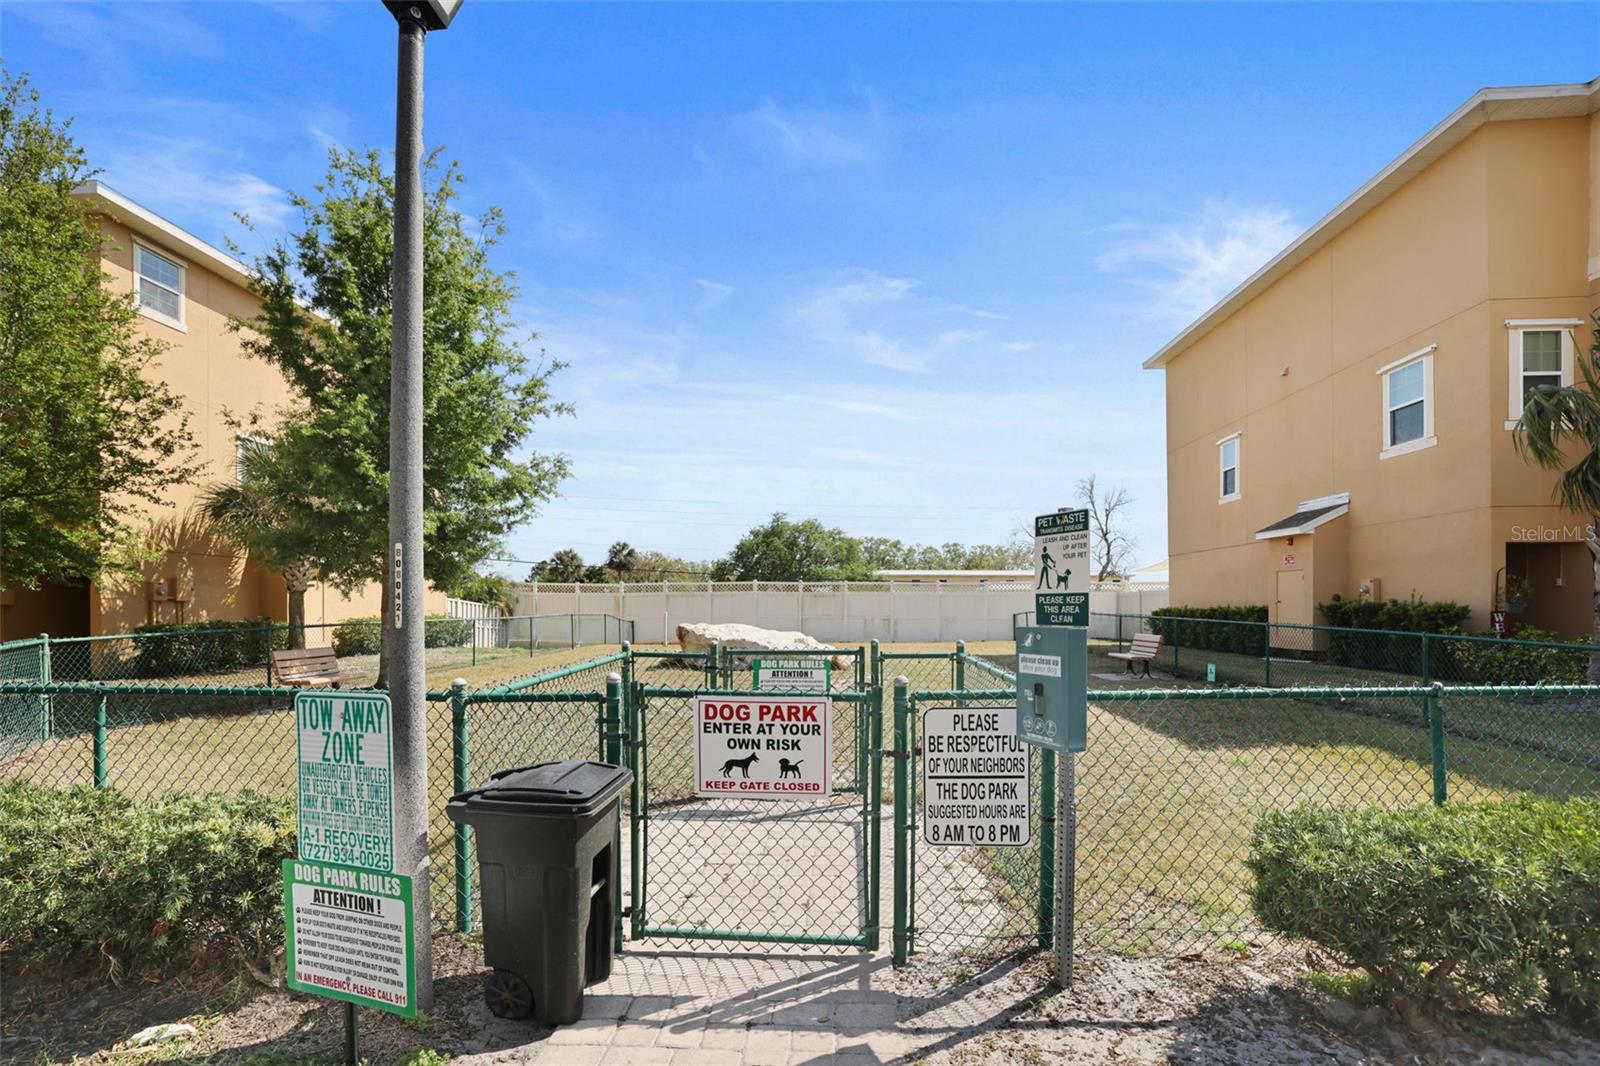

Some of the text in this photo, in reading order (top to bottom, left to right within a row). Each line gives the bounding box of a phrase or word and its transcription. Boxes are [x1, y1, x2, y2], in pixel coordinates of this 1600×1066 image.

[1038, 512, 1085, 528] PET WASTE
[1064, 523, 1084, 532] DISEASE
[1042, 536, 1058, 544] LEASH
[1070, 532, 1088, 541] CLEAN
[1071, 542, 1088, 550] AFTER
[1062, 551, 1087, 560] YOUR PET
[1038, 595, 1085, 605] PLEASE KEEP
[1044, 605, 1080, 614] THIS AREA
[761, 660, 825, 668] DOG PARK RULES
[300, 699, 385, 734] TOW AWAY
[704, 703, 818, 722] DOG PARK
[703, 722, 821, 736] ENTER AT YOUR
[953, 714, 999, 731] PLEASE
[322, 731, 365, 765] ZONE
[727, 738, 801, 751] OWN RISK
[928, 735, 944, 753] BE
[947, 735, 1024, 753] RESPECTFUL
[302, 761, 388, 785] UNAUTHORIZED VEHICLES
[929, 757, 1025, 773] OF YOUR NEIGHBORS
[312, 779, 338, 797] VESSELS
[340, 781, 354, 799] WILL
[356, 783, 364, 799] BE
[366, 784, 388, 802] TOWED
[705, 781, 820, 792] KEEP GATE CLOSED
[936, 783, 1018, 800] THE DOG PARK
[330, 797, 356, 816] OWNERS
[359, 800, 388, 819] EXPENSE
[928, 804, 1026, 819] SUGGESTED HOURS ARE
[303, 826, 389, 853] A-1 RECOVERY
[932, 824, 1020, 842] 8 AM TO 8 PM
[294, 863, 401, 897] DOG PARK RULES
[313, 888, 374, 914] ATTENTION
[303, 972, 312, 982] AN
[353, 983, 376, 998] PLEASE
[377, 989, 394, 1003] CALL
[394, 994, 406, 1006] 911
